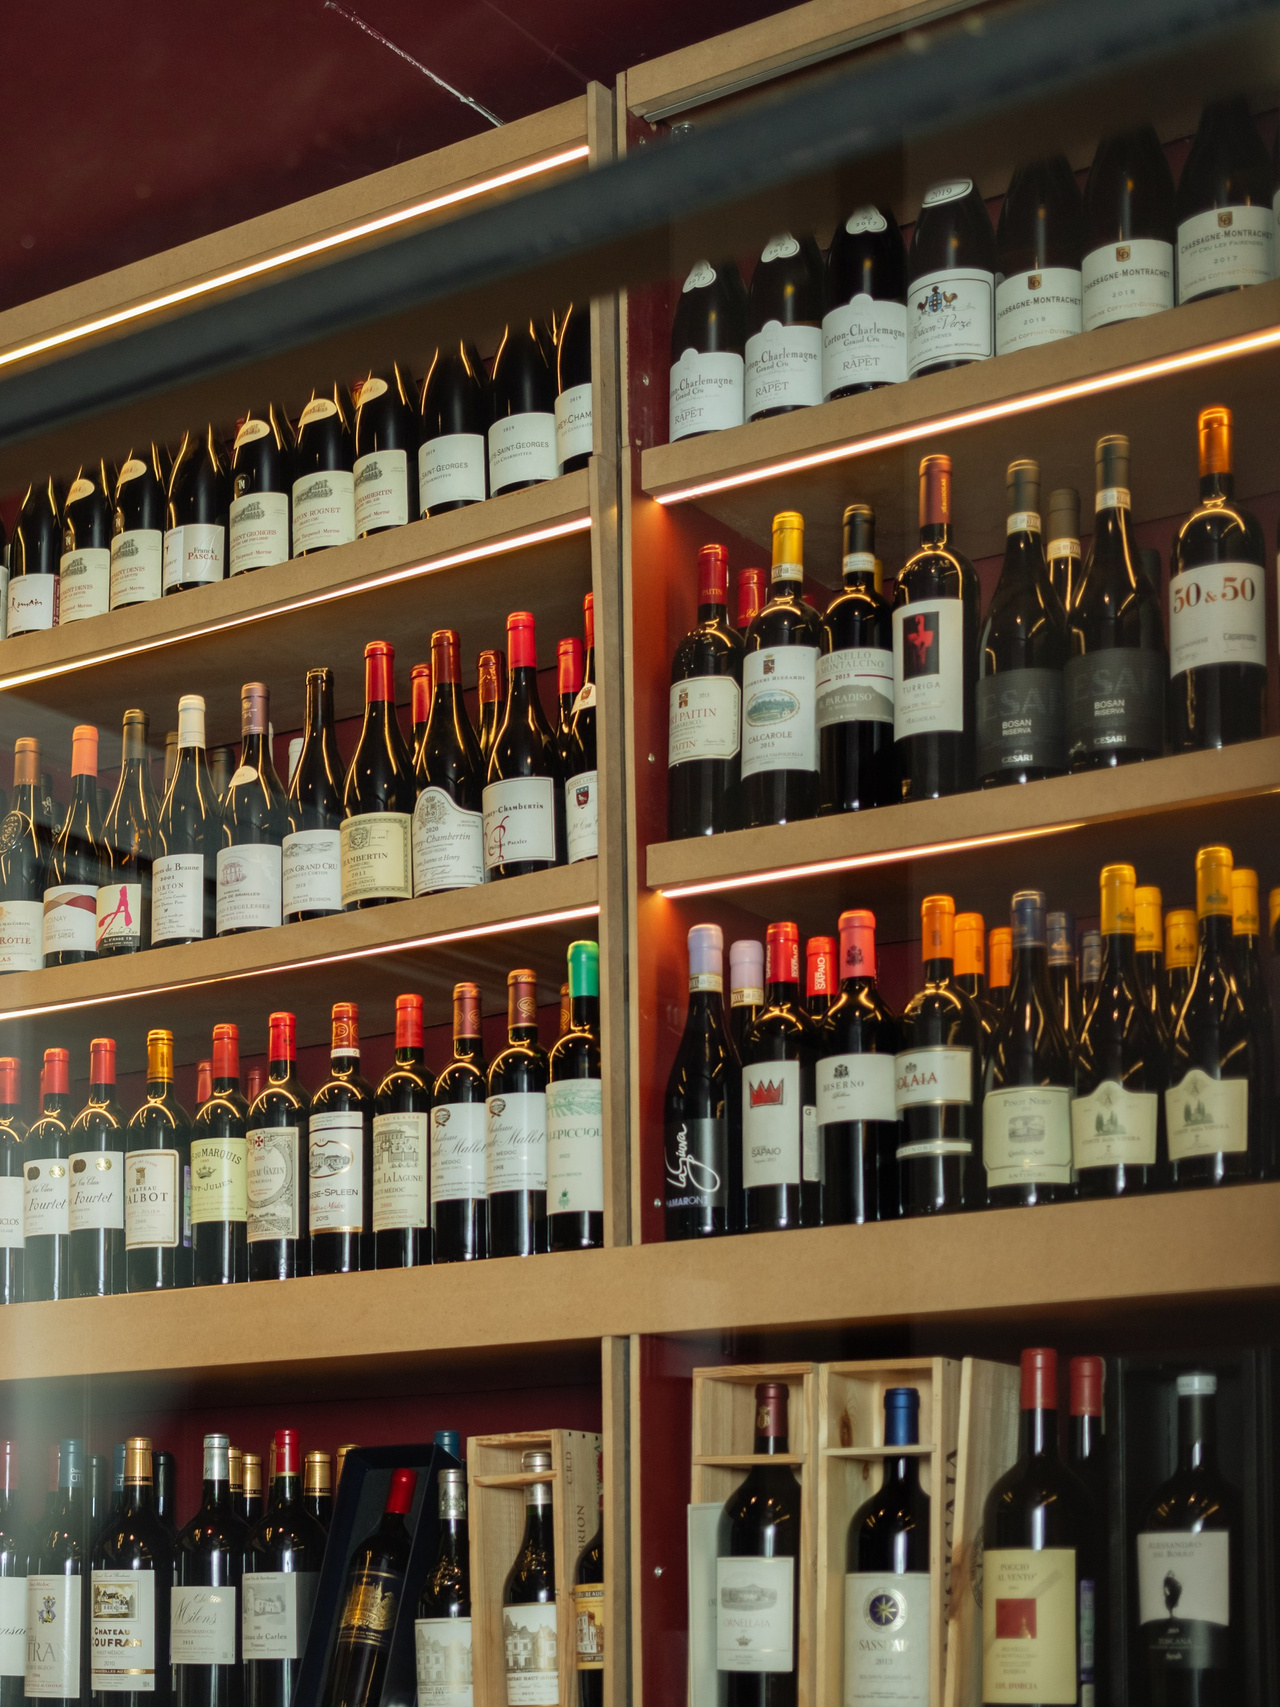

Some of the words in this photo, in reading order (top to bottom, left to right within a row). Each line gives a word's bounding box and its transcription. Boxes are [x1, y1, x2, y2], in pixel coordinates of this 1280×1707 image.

[930, 187, 952, 200] 2019
[1083, 268, 1171, 293] CHASSAGNE-MONTRACHET
[997, 296, 1082, 321] CHASSAGNE-MONTRACHET
[824, 322, 906, 348] Corton-Charlemagne
[843, 336, 865, 347] Grand
[756, 363, 774, 374] Grand
[842, 357, 880, 370] RAPET
[675, 389, 691, 401] Grand
[692, 387, 704, 396] Cru
[755, 381, 789, 397] RAPET
[674, 408, 704, 425] RAPET
[309, 507, 341, 516] ROGNET
[187, 552, 220, 561] PASCAL
[1173, 583, 1201, 615] 50
[1204, 590, 1218, 604] &
[1221, 577, 1256, 602] 50
[903, 682, 941, 694] TURRIGA
[825, 692, 873, 707] PARADISO
[1094, 700, 1125, 710] BOSAN
[679, 707, 717, 722] PAITIN
[1093, 708, 1125, 717] RISERVA
[1002, 718, 1032, 729] BOSAN
[1002, 727, 1032, 736] RISERVA
[748, 731, 793, 745] CALCAROLE
[1093, 735, 1127, 745] CESARI
[1002, 753, 1033, 764] CESARI
[426, 826, 439, 834] 2020
[175, 863, 200, 871] Beaune
[295, 864, 322, 873] GRAND
[322, 862, 338, 871] CRU
[817, 957, 826, 990] SAPAIO
[823, 1080, 864, 1093] BISERNO
[201, 1147, 242, 1165] MARQUIS
[751, 1147, 781, 1158] SAPAIO
[263, 1165, 285, 1177] GAZIN
[383, 1172, 392, 1183] LA
[392, 1171, 423, 1182] LAGUNE
[74, 1191, 114, 1205] Fourtet
[29, 1198, 67, 1212] Fourtet
[1000, 1564, 1030, 1572] POGGIO
[1007, 1573, 1034, 1582] VENTO
[94, 1627, 131, 1636] CHATEAU
[265, 1632, 287, 1640] Carles
